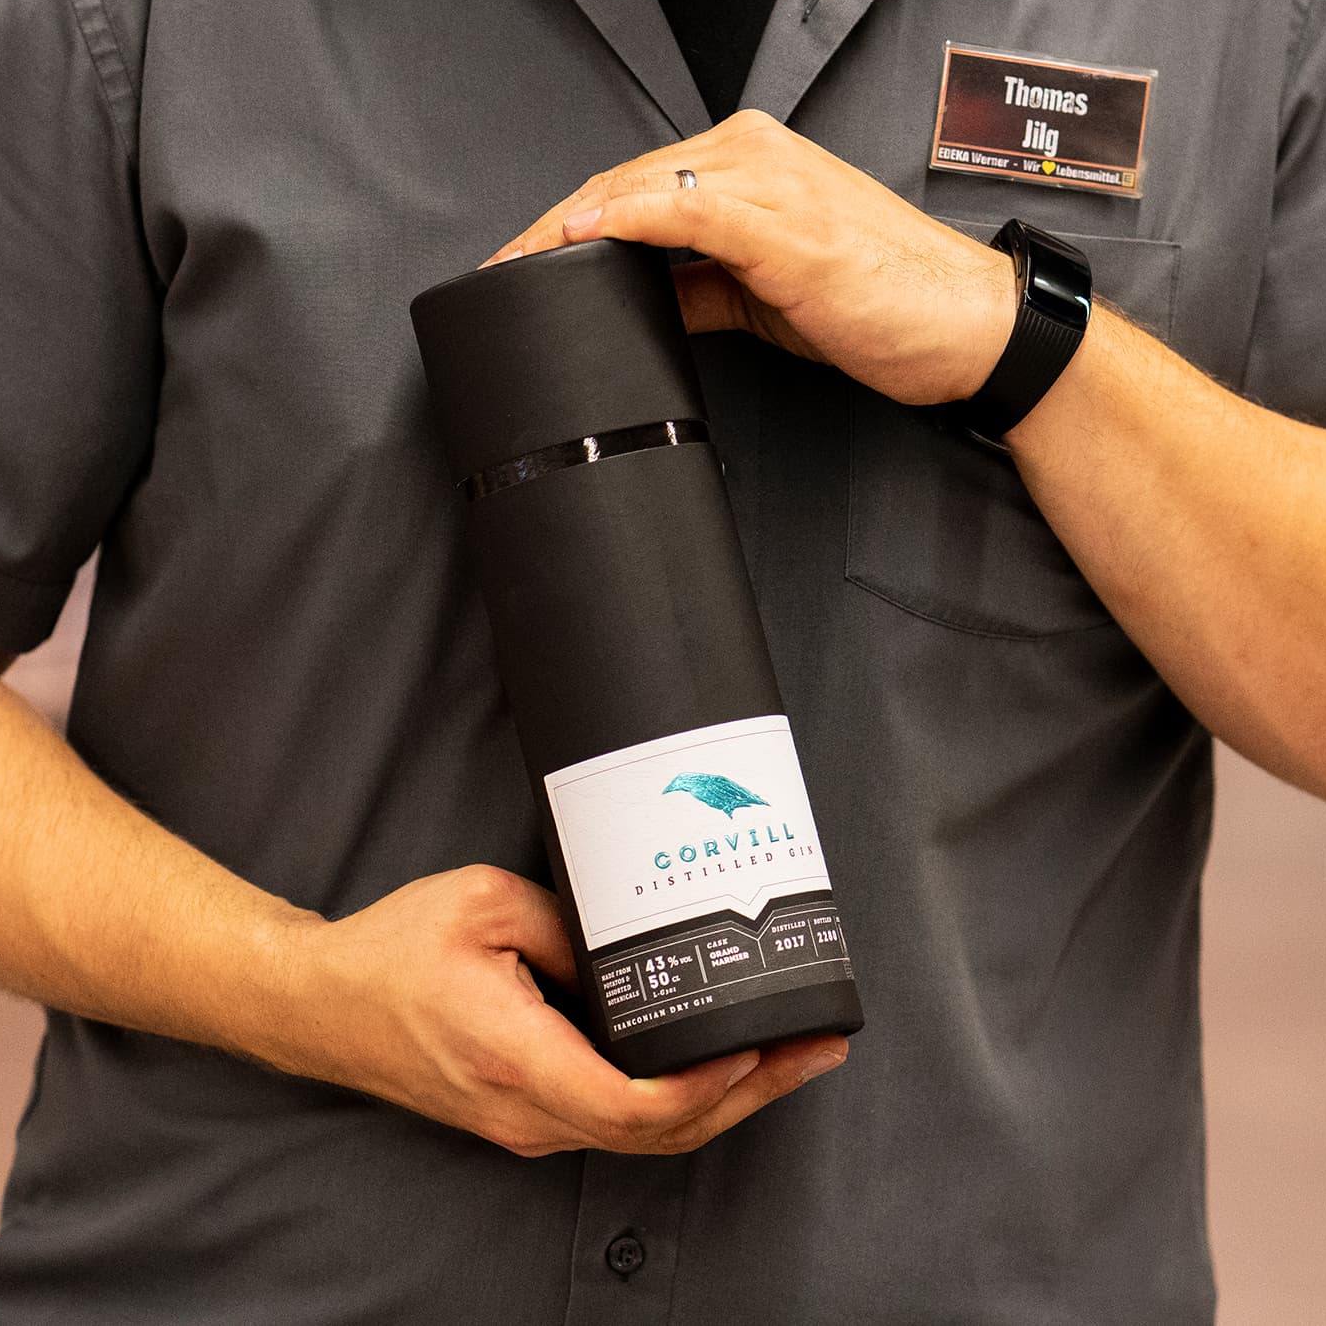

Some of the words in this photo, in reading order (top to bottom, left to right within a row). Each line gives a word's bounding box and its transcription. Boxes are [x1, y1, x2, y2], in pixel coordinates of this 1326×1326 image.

[1004, 75, 1089, 116] Thomas
[1021, 119, 1060, 158] Jilg
[937, 146, 970, 163] EDEKA
[971, 152, 1009, 168] Werner
[1023, 159, 1042, 173] Wir
[654, 822, 795, 870] CORVILL
[635, 852, 773, 896] DISTILLED
[788, 845, 813, 858] GIN
[771, 920, 806, 934] DISTILLED
[706, 938, 729, 950] CASK
[775, 934, 805, 952] 2017
[709, 945, 740, 960] GRAND
[711, 952, 750, 968] MARNIER
[615, 965, 632, 977] FROM
[645, 955, 666, 973] 43
[667, 954, 679, 969] %
[679, 955, 693, 965] VOL
[647, 971, 671, 989] 50
[607, 989, 640, 1007] BOTANICALS
[613, 1008, 666, 1032] FRANCONIAN
[669, 1001, 690, 1014] DRY
[693, 995, 713, 1007] GIN
